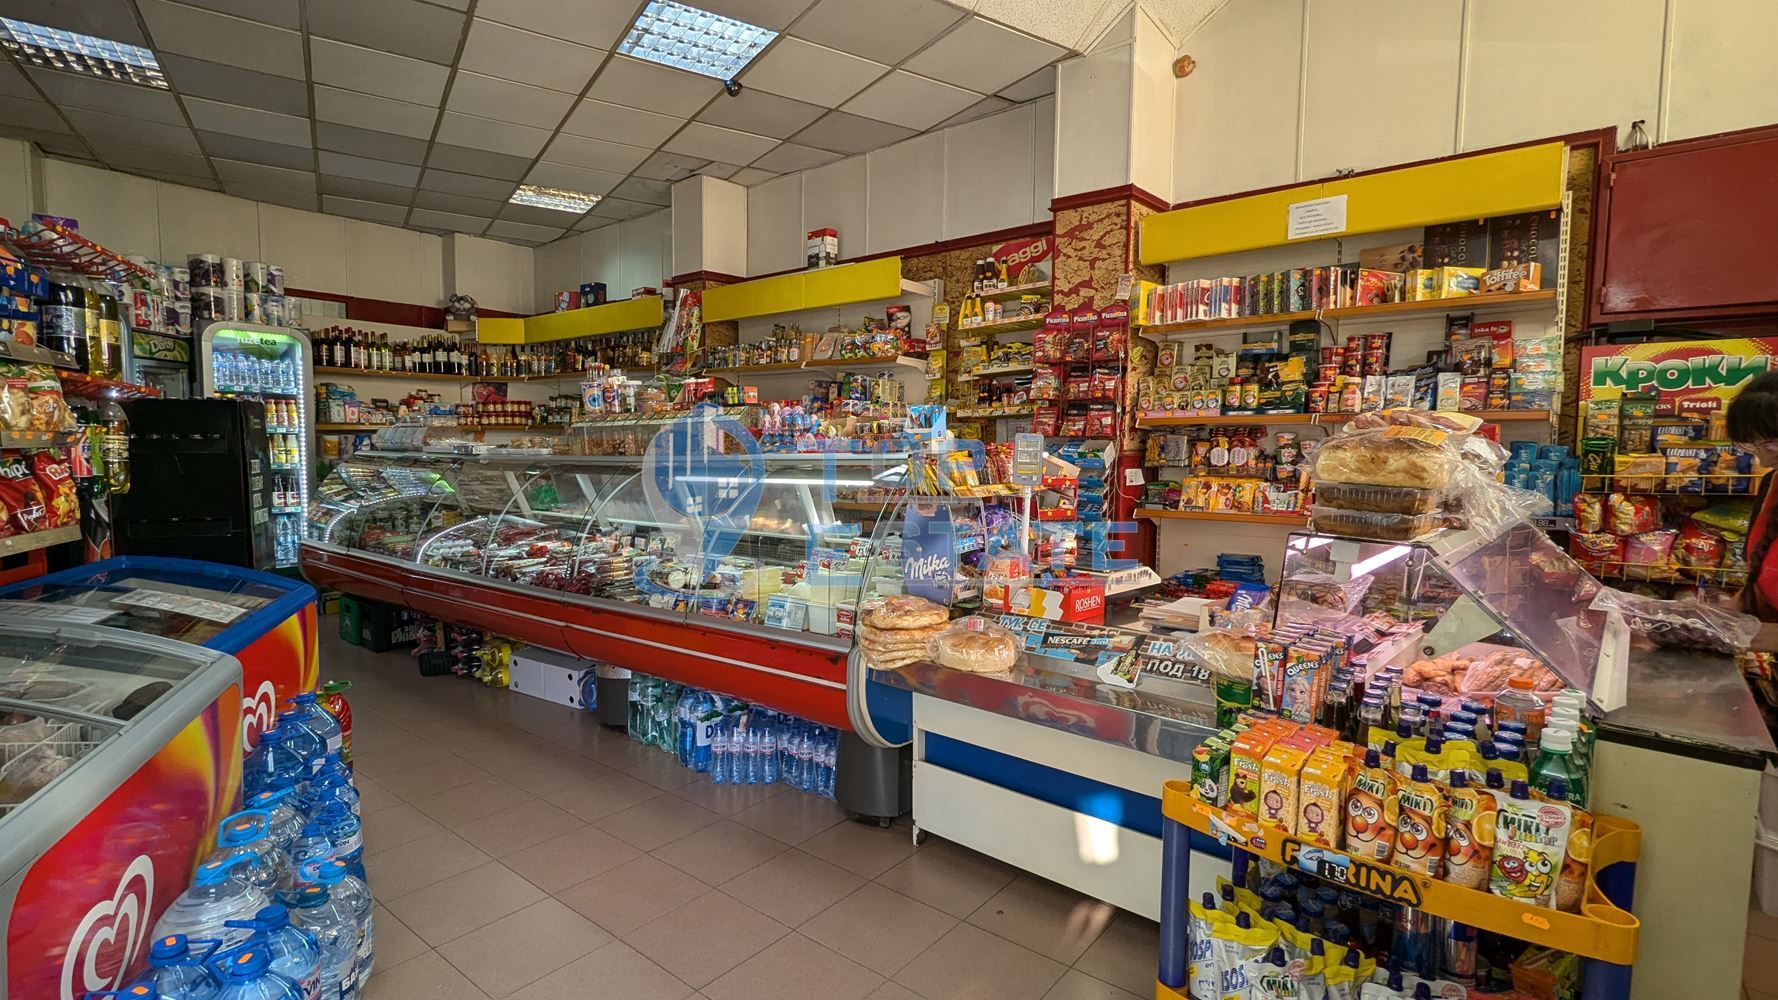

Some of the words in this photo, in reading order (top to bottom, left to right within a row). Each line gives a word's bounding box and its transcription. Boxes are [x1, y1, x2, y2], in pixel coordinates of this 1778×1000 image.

[998, 238, 1047, 267] aggi
[1483, 268, 1528, 287] Toffifee
[1591, 353, 1770, 393] КРОКИ
[0, 459, 31, 480] hipi
[904, 554, 951, 580] Milka
[1075, 594, 1101, 611] ROSHEN
[999, 614, 1026, 630] ТУК
[1148, 641, 1174, 656] НА
[1147, 659, 1186, 678] ПОД
[1234, 758, 1259, 772] Fresh
[1304, 783, 1333, 799] Fresh
[1400, 793, 1430, 812] MIKI
